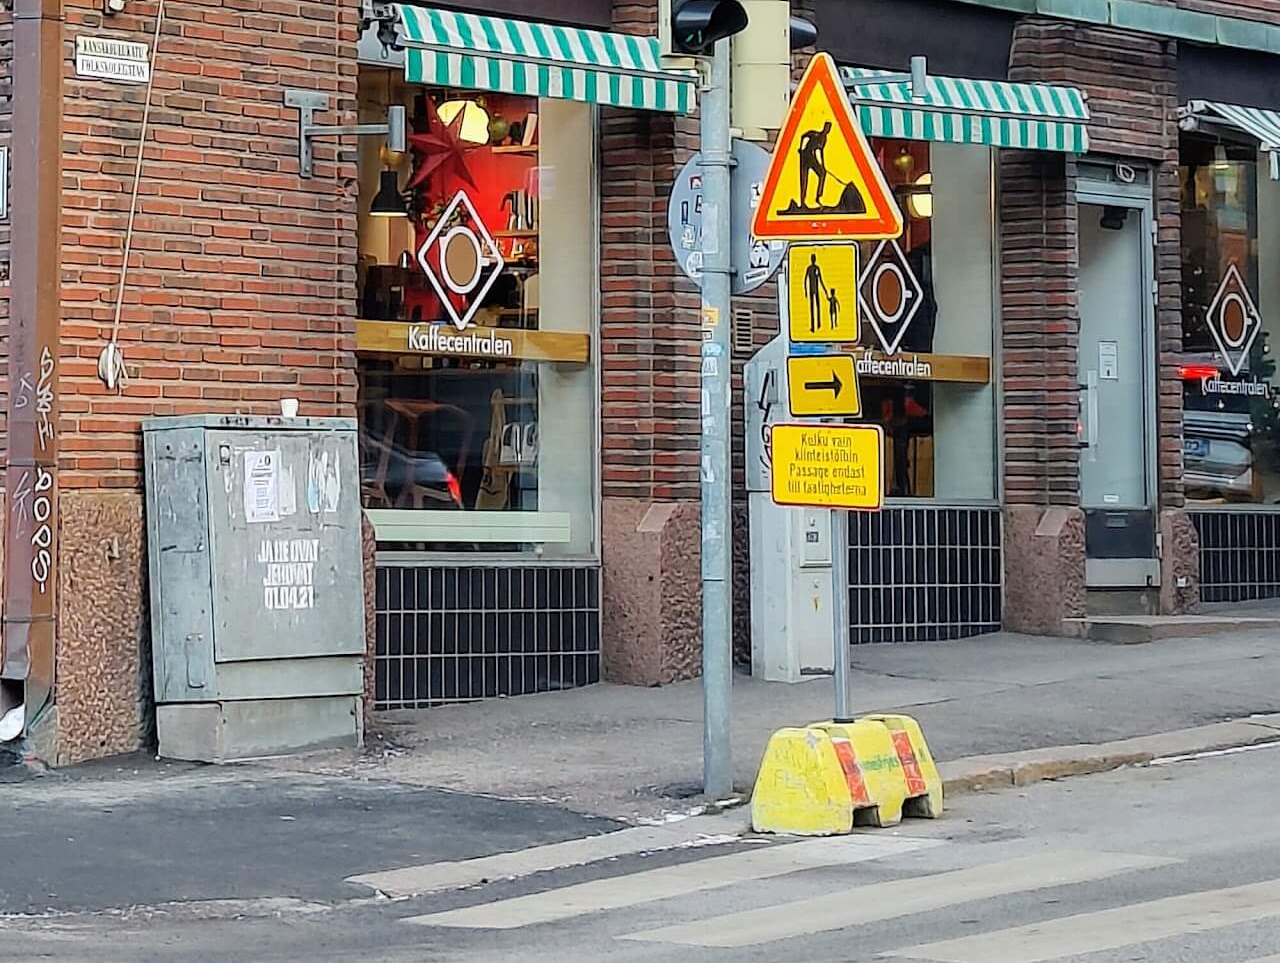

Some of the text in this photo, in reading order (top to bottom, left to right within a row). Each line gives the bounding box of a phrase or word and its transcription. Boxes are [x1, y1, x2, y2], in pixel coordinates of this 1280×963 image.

[408, 324, 513, 356] Kaffecentralen
[854, 351, 932, 378] affecentralen
[1201, 373, 1270, 399] Kaffecentralen
[831, 436, 852, 448] vain
[789, 462, 865, 479] Passage endast
[787, 479, 801, 494] till
